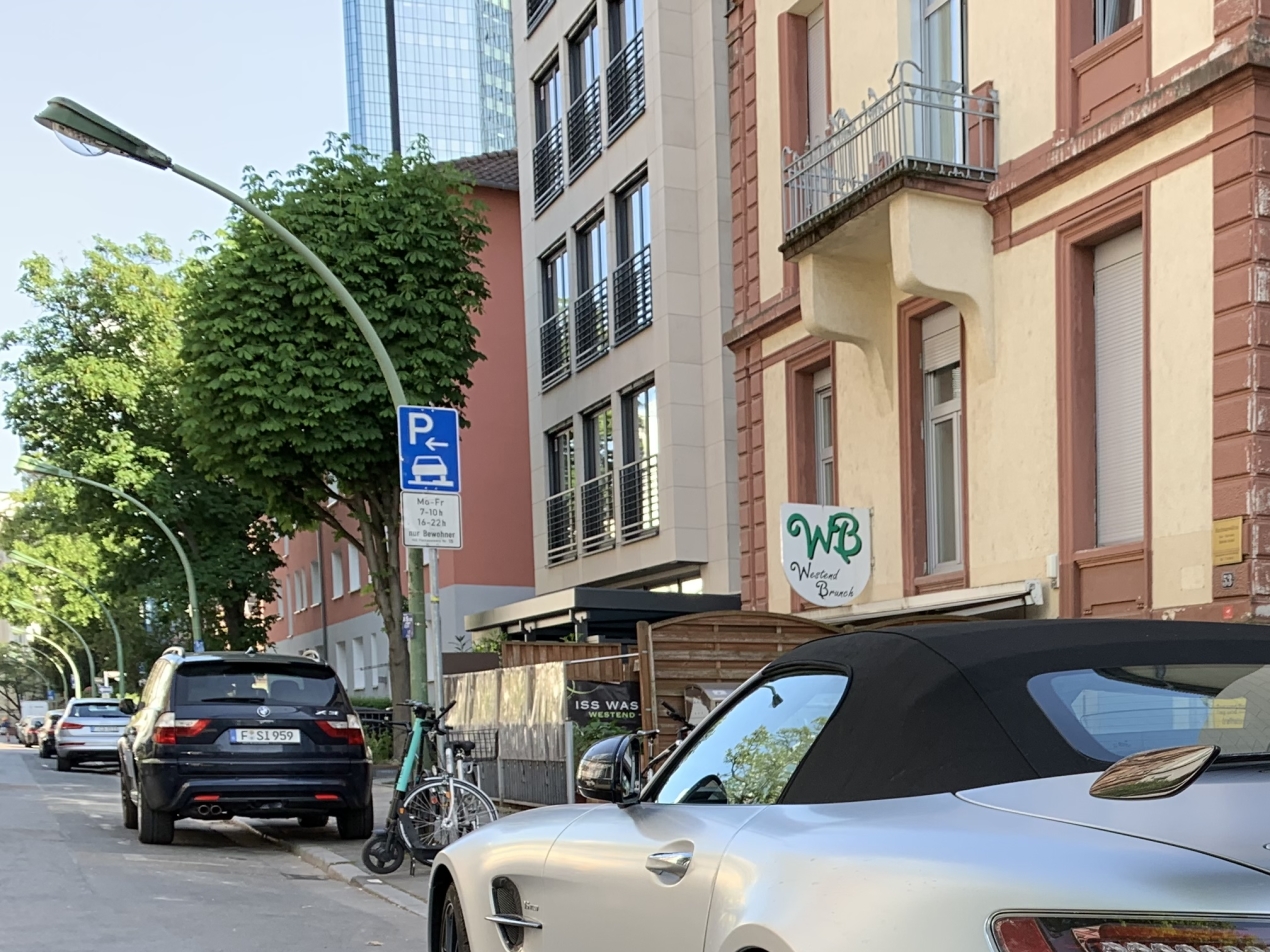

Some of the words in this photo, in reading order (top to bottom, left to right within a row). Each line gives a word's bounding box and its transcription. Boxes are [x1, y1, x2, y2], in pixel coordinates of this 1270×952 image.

[408, 412, 434, 445] P
[422, 530, 456, 539] Bewohner
[786, 512, 863, 565] WB
[790, 562, 841, 581] Westend
[815, 580, 855, 599] Brunch
[575, 700, 600, 710] ISS
[605, 700, 639, 711] WAS
[588, 711, 636, 719] WESTEND
[241, 731, 248, 741] F
[272, 731, 294, 741] 959
